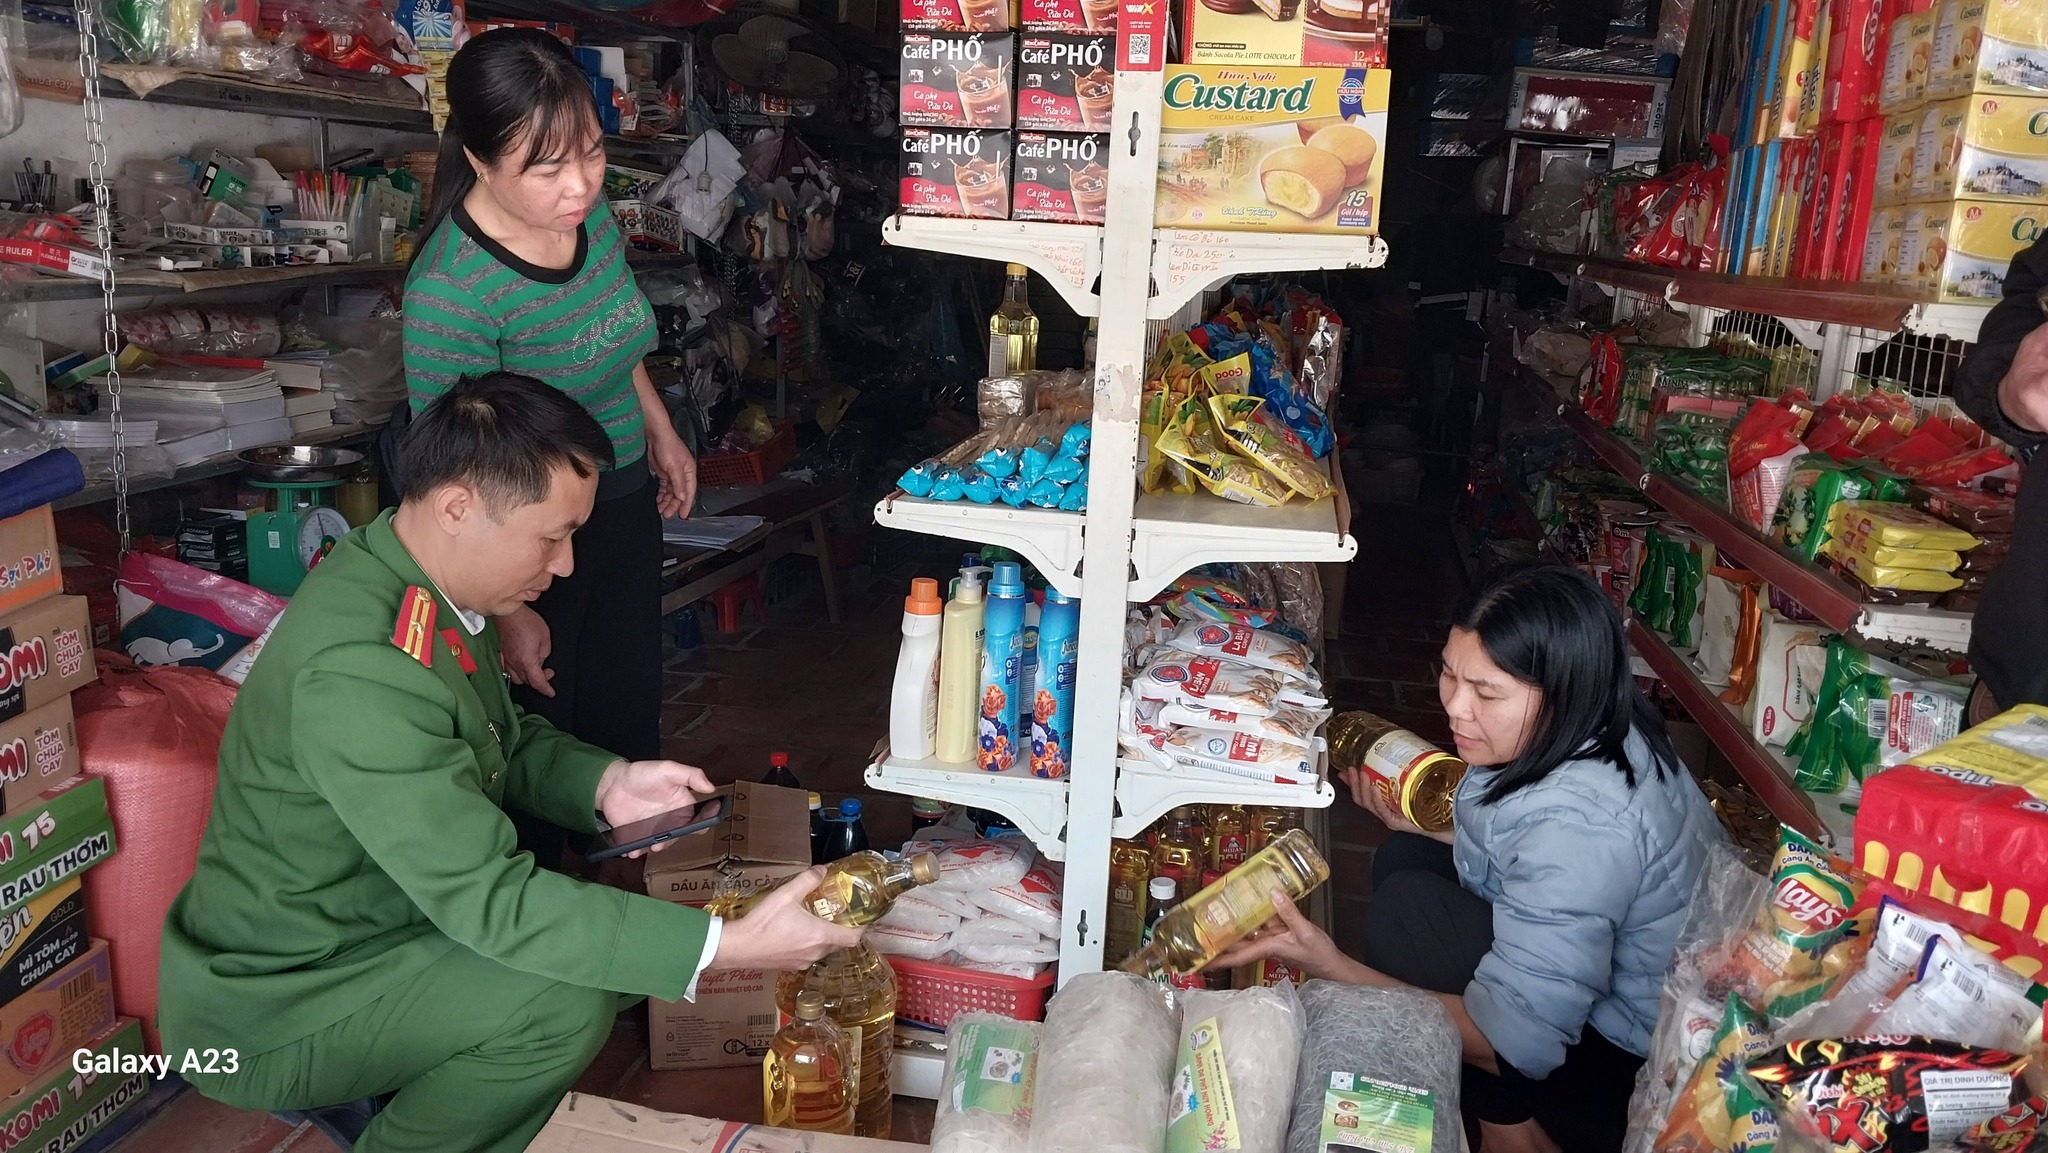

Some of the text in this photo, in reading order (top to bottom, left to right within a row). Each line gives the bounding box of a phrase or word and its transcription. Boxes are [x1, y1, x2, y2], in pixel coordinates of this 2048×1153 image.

[942, 7, 952, 16] Đá
[1062, 9, 1074, 18] Đá
[902, 33, 982, 60] Café PHỐ
[1022, 38, 1104, 66] Café PHỐ
[1354, 51, 1364, 61] 12
[54, 78, 72, 92] cay
[1164, 73, 1317, 114] Custard
[924, 90, 938, 103] phê
[1042, 97, 1055, 108] phê
[942, 102, 953, 110] Đá
[1060, 106, 1072, 116] Đá
[902, 130, 981, 156] Café PHỐ
[1017, 134, 1098, 160] Café PHỐ
[923, 185, 936, 196] phê
[940, 194, 952, 203] Đá
[1037, 190, 1050, 200] phê
[1346, 190, 1368, 207] 15
[1054, 200, 1066, 208] Đá
[6, 246, 32, 256] RULER
[22, 549, 52, 578] Phở
[54, 630, 79, 650] TÔM
[54, 643, 84, 666] CHUA
[60, 658, 82, 677] CAY
[35, 728, 60, 749] TÔM
[36, 740, 65, 764] CHUA
[41, 757, 62, 777] CAY
[22, 810, 56, 852] 75
[0, 831, 109, 910] RAU THƠM
[670, 880, 698, 892] DẦU
[1114, 888, 1134, 900] GOLD
[1774, 878, 1842, 926] Lay's
[50, 901, 74, 922] GOLD
[18, 954, 34, 974] MÌ
[34, 938, 60, 962] TÔM
[20, 942, 77, 986] CHUA CAY
[730, 968, 764, 982] Phẩm
[1744, 1040, 1768, 1052] Càng
[1924, 1071, 2009, 1086] GIÁ TRỊ DINH DƯỠNG
[89, 1075, 144, 1126] THƠM
[1746, 1132, 1770, 1142] Càng
